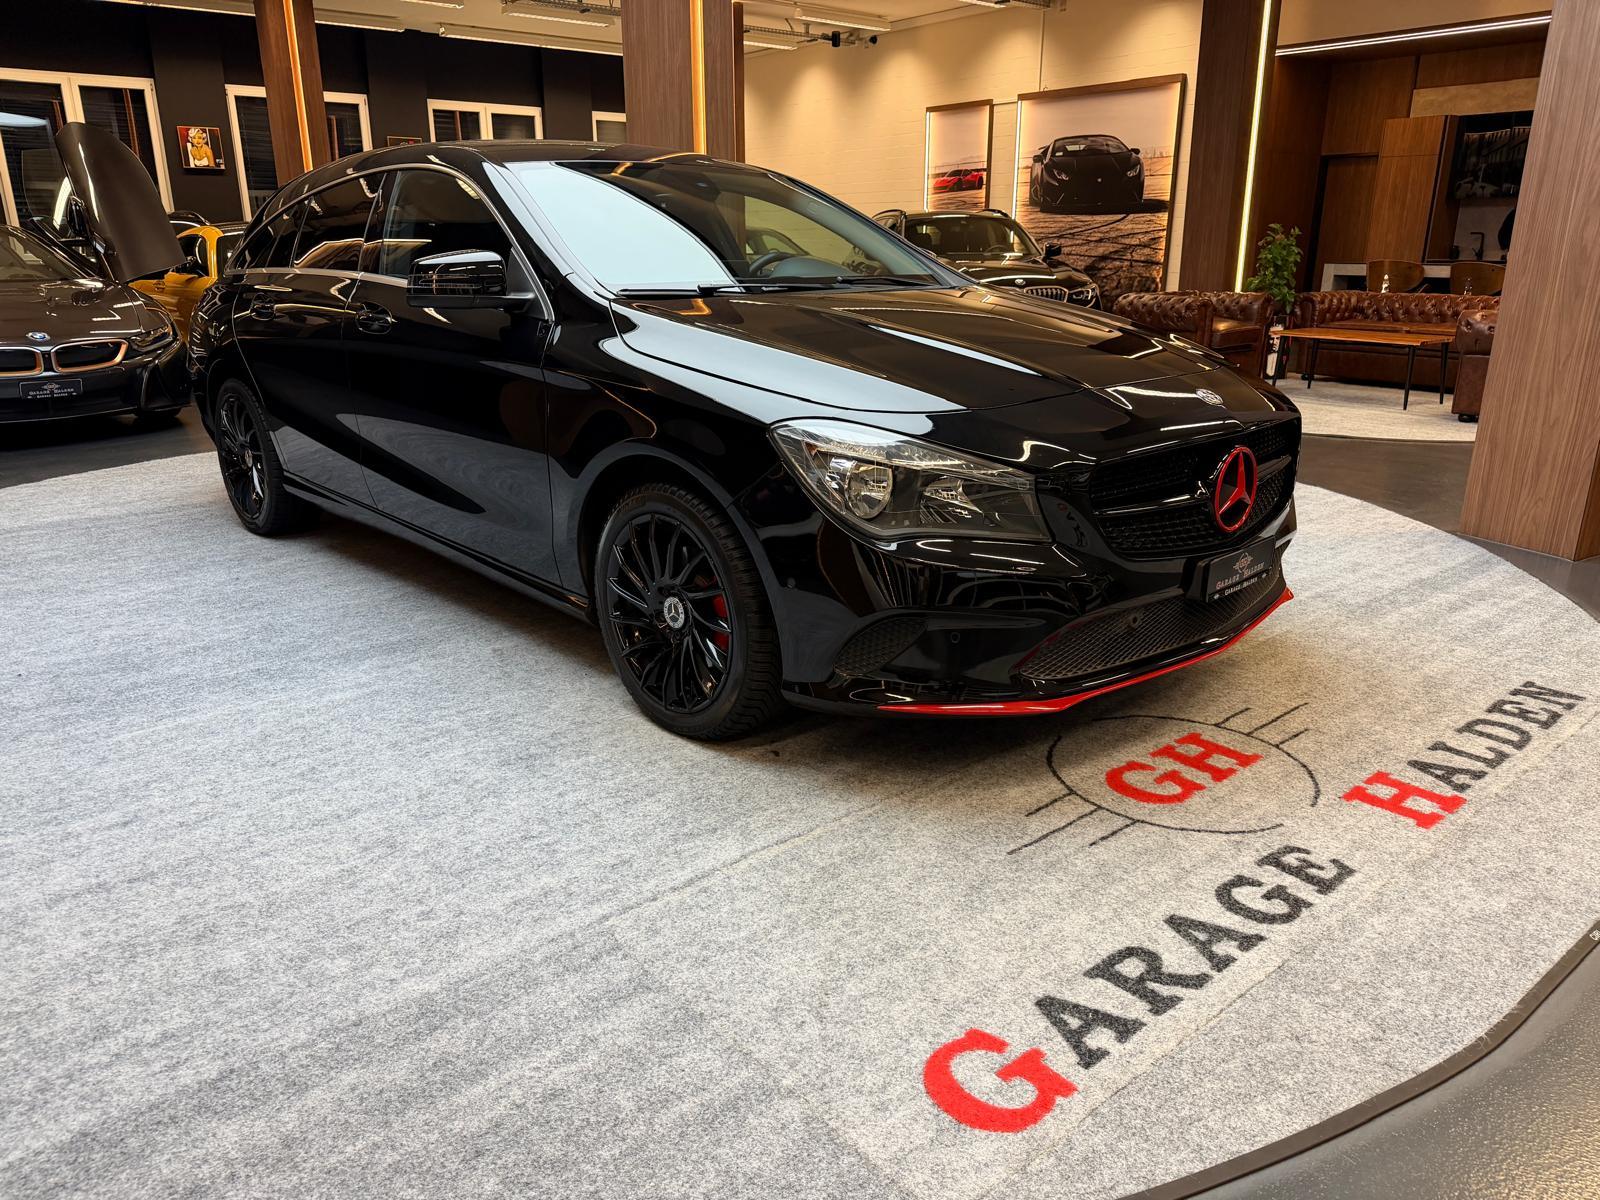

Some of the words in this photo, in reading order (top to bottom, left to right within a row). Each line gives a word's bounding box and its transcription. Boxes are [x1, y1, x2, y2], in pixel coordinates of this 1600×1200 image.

[1105, 732, 1264, 805] GH
[922, 845, 1356, 1134] GARAGE
[1341, 680, 1587, 830] HALDEN
